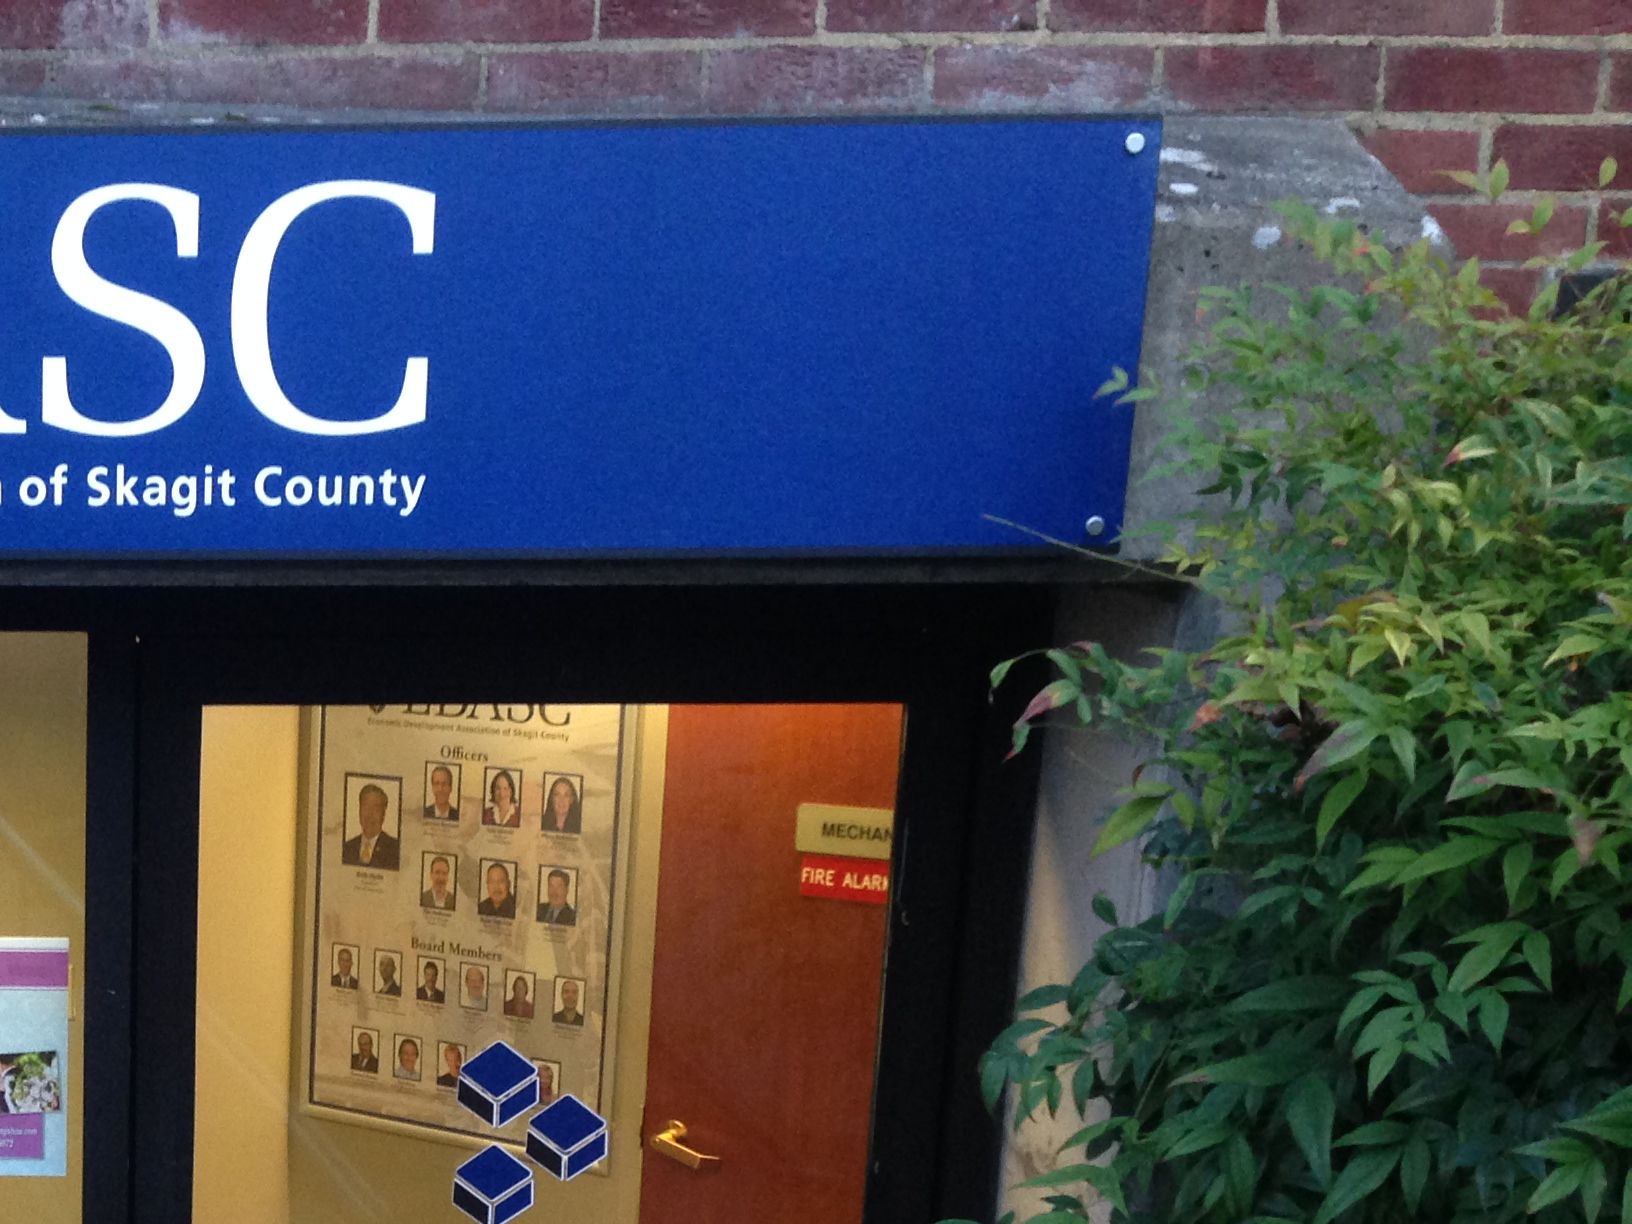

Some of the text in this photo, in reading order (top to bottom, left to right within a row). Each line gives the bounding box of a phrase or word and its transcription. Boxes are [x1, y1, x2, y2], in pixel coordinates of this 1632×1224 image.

[17, 464, 69, 508] of
[85, 466, 237, 516] Skagit
[253, 467, 427, 517] County
[403, 718, 454, 733] Development
[456, 724, 501, 736] Association
[503, 726, 512, 737] of
[513, 728, 539, 741] Skagit
[541, 731, 569, 743] County
[440, 744, 489, 763] Officers
[801, 866, 836, 887] FIRE
[411, 936, 504, 963] Board Members
